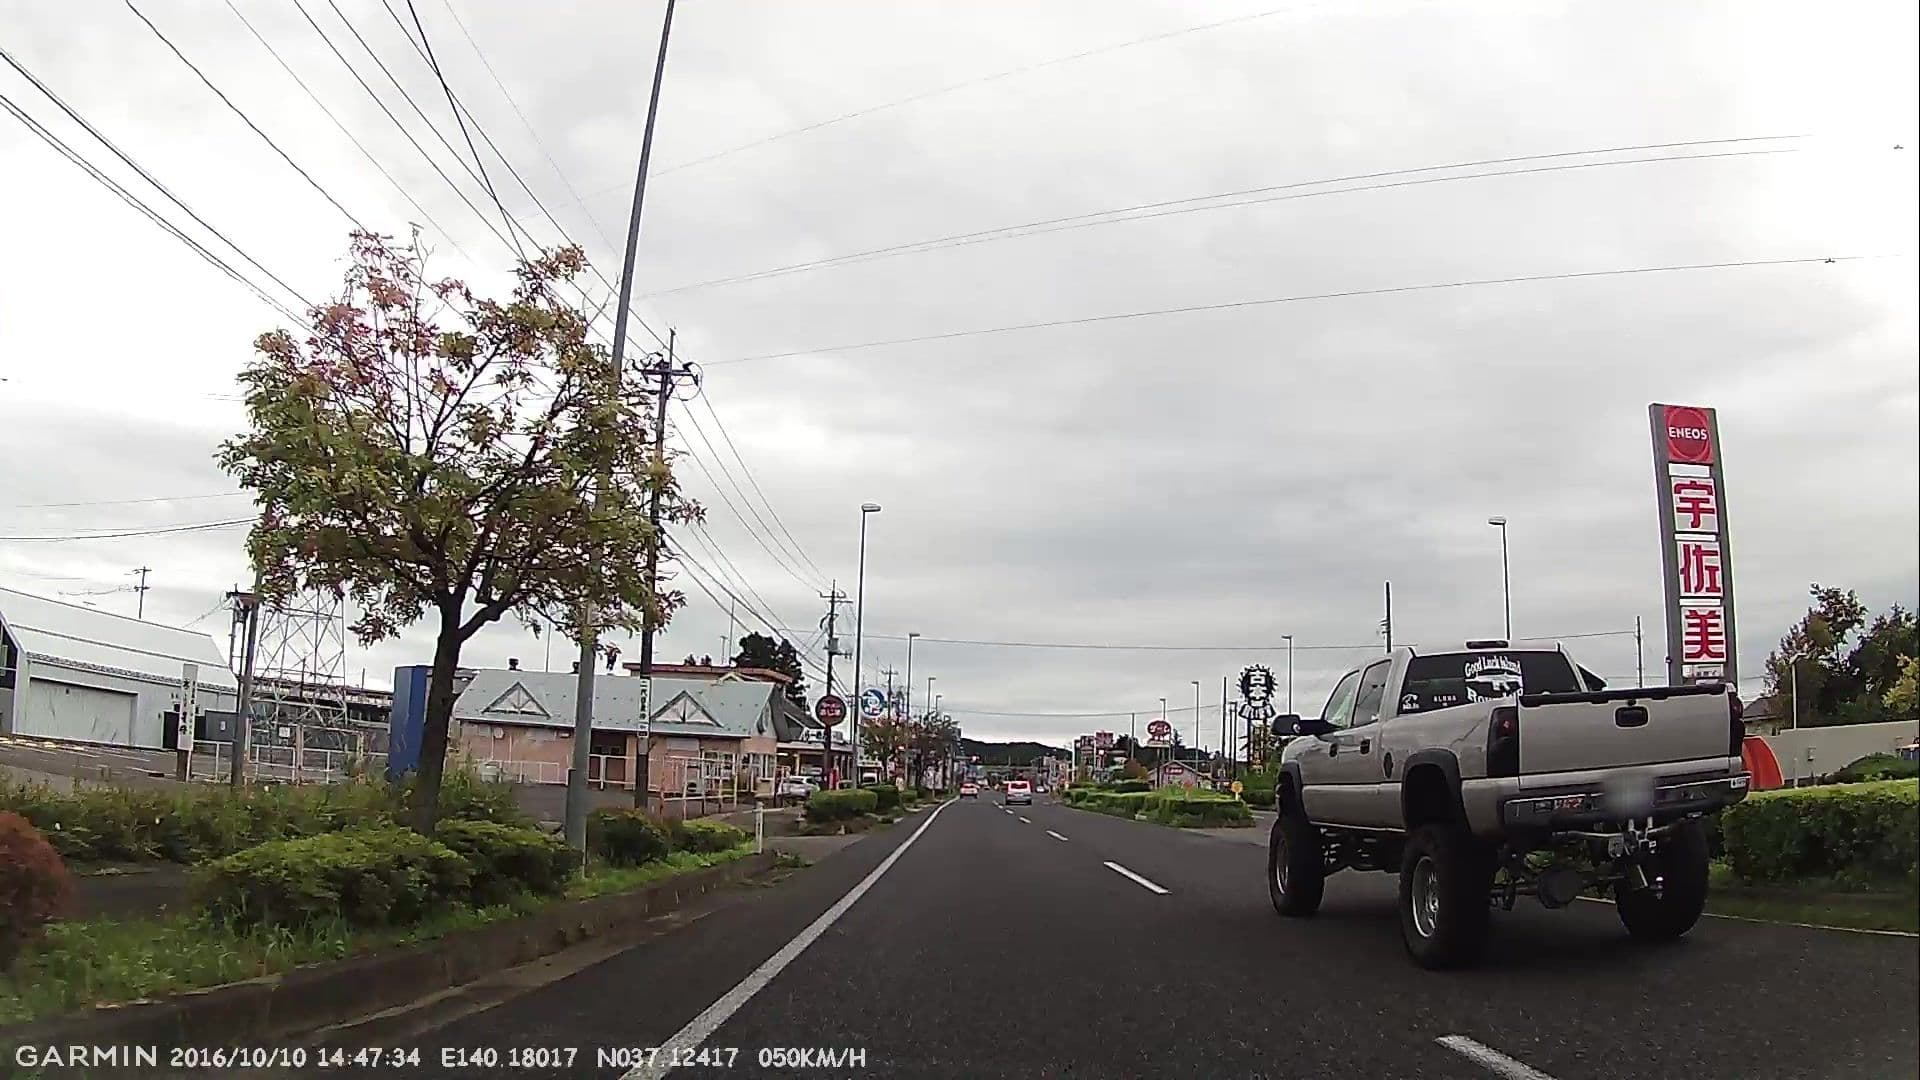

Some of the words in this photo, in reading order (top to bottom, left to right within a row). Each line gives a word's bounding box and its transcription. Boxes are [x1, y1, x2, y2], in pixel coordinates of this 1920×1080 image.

[1669, 426, 1708, 441] ENEOS
[1673, 480, 1725, 660] 宇佐美
[1465, 656, 1483, 677] Good
[1482, 655, 1500, 670] Luck
[1249, 669, 1268, 701] 古本
